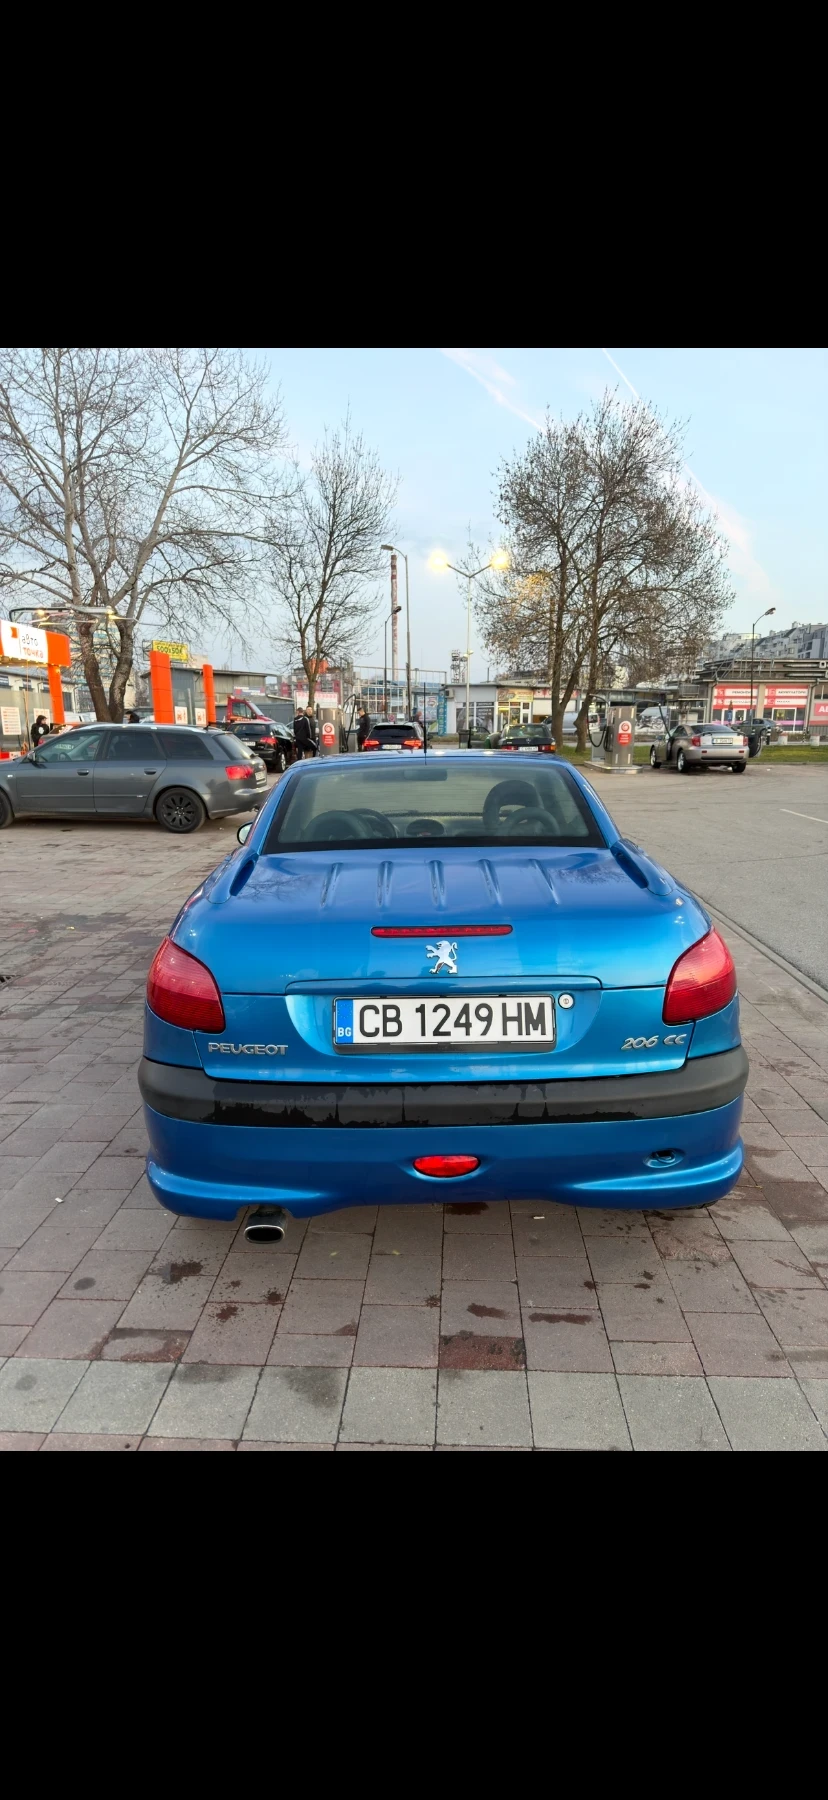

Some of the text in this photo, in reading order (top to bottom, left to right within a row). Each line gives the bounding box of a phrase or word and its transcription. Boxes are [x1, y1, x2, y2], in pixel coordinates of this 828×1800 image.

[359, 1002, 547, 1038] CB 1249 HM
[337, 1027, 352, 1038] BG
[208, 1042, 289, 1055] PEUGEOT
[620, 1033, 688, 1050] 206 CC
